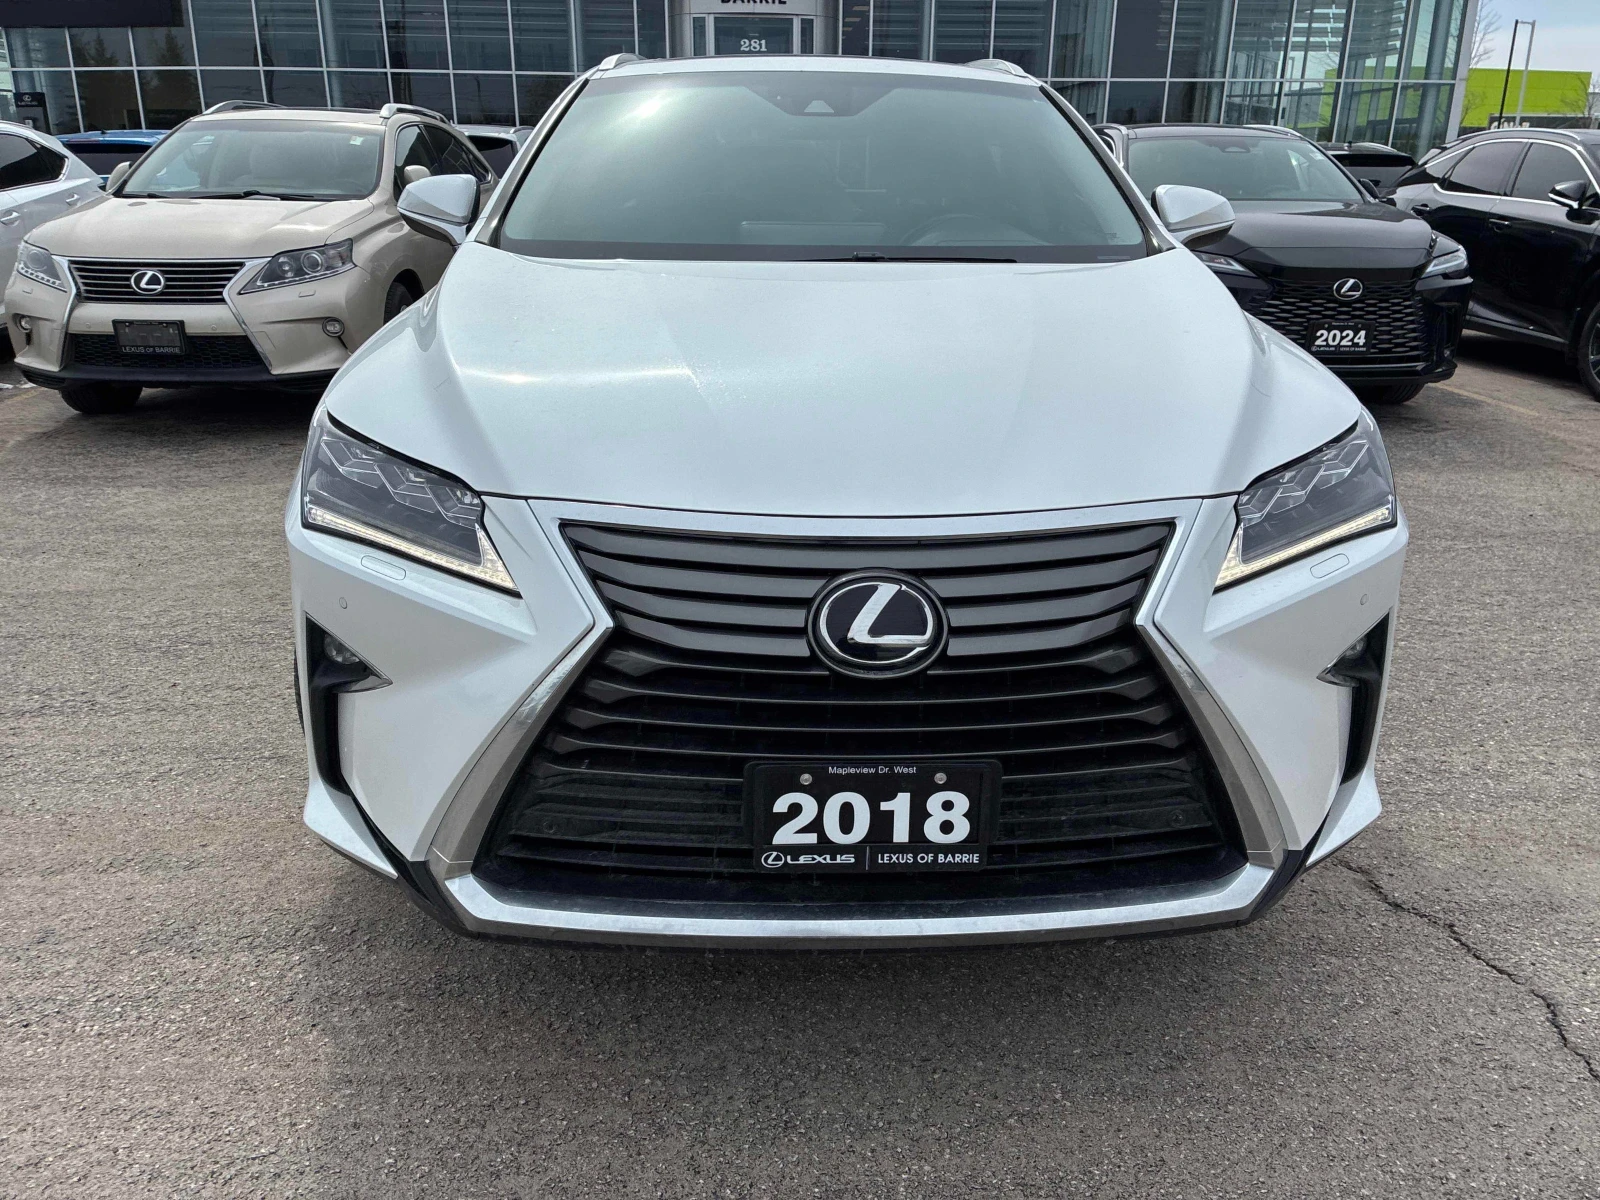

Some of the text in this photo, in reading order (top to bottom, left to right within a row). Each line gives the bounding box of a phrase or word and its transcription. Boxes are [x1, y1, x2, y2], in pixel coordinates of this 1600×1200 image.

[740, 39, 767, 51] 281
[1314, 329, 1366, 346] 2024
[828, 765, 917, 775] Mapleview Dr. West
[772, 791, 970, 845] 2018
[786, 854, 855, 864] LEXUS
[878, 853, 980, 863] LEXUS OF BARRIE
